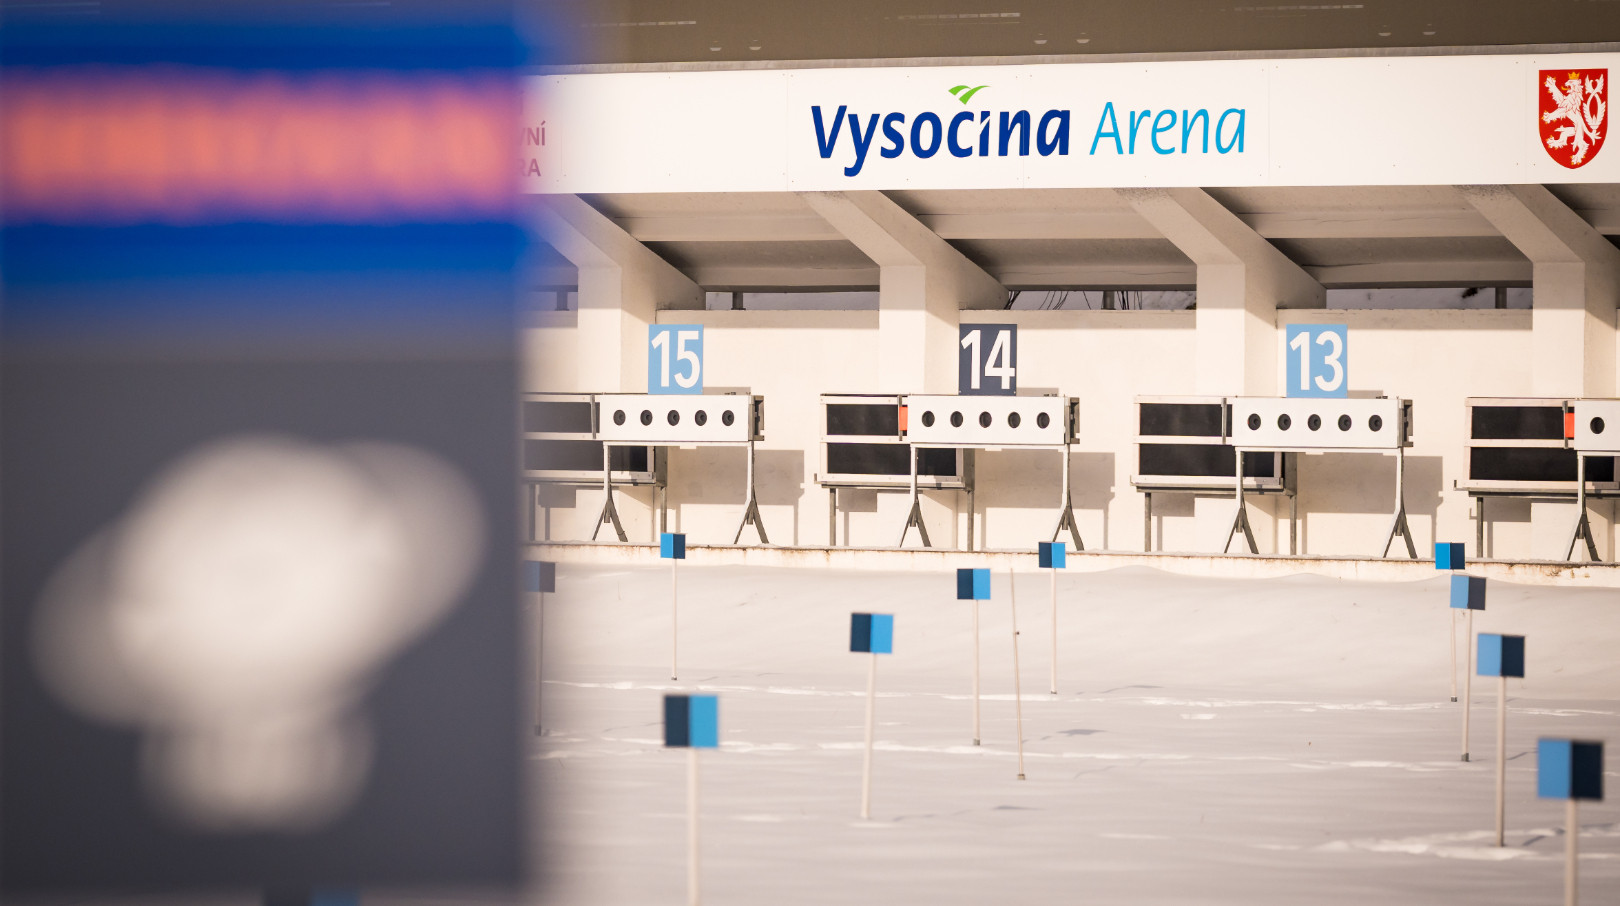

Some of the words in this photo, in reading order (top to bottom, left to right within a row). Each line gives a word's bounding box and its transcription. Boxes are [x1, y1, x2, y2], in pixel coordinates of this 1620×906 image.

[811, 85, 1071, 177] Vysočina
[1089, 101, 1246, 156] Arena
[651, 330, 701, 389] 15
[960, 329, 1016, 390] 14
[1289, 330, 1344, 392] 13
